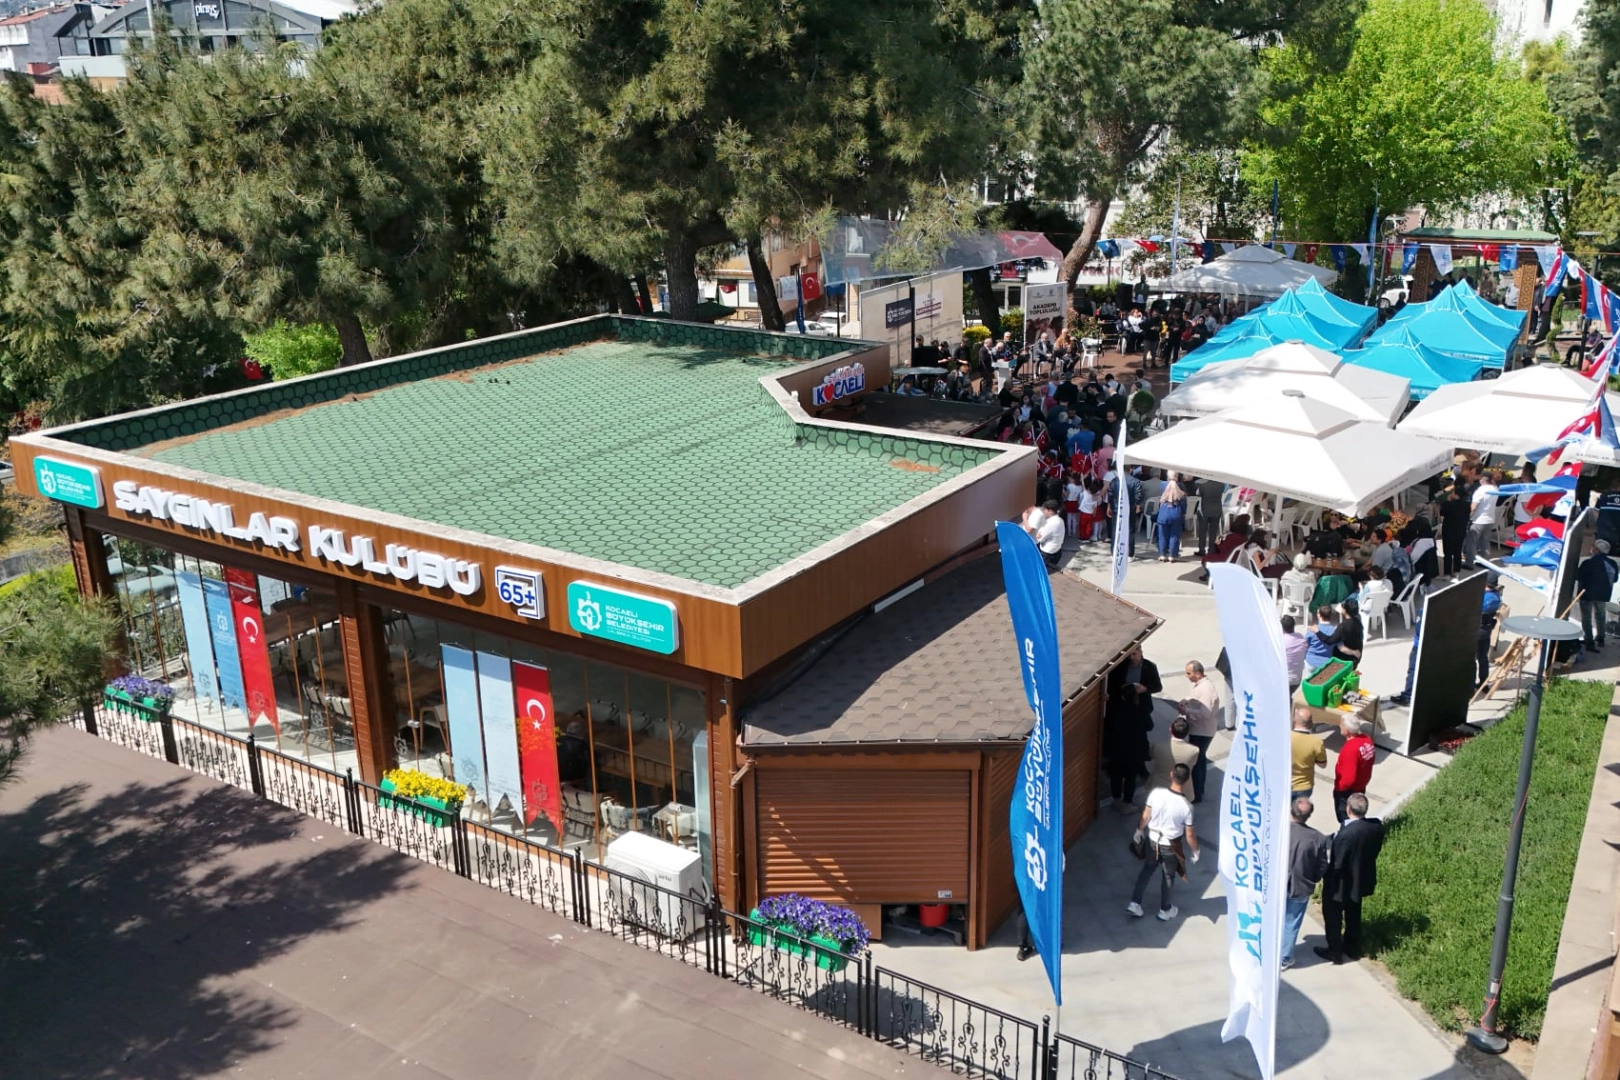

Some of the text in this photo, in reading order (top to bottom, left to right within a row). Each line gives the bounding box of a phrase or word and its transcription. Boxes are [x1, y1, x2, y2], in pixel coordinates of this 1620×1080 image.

[113, 480, 536, 605] SAYGINLAR KULÜBÜ 65+
